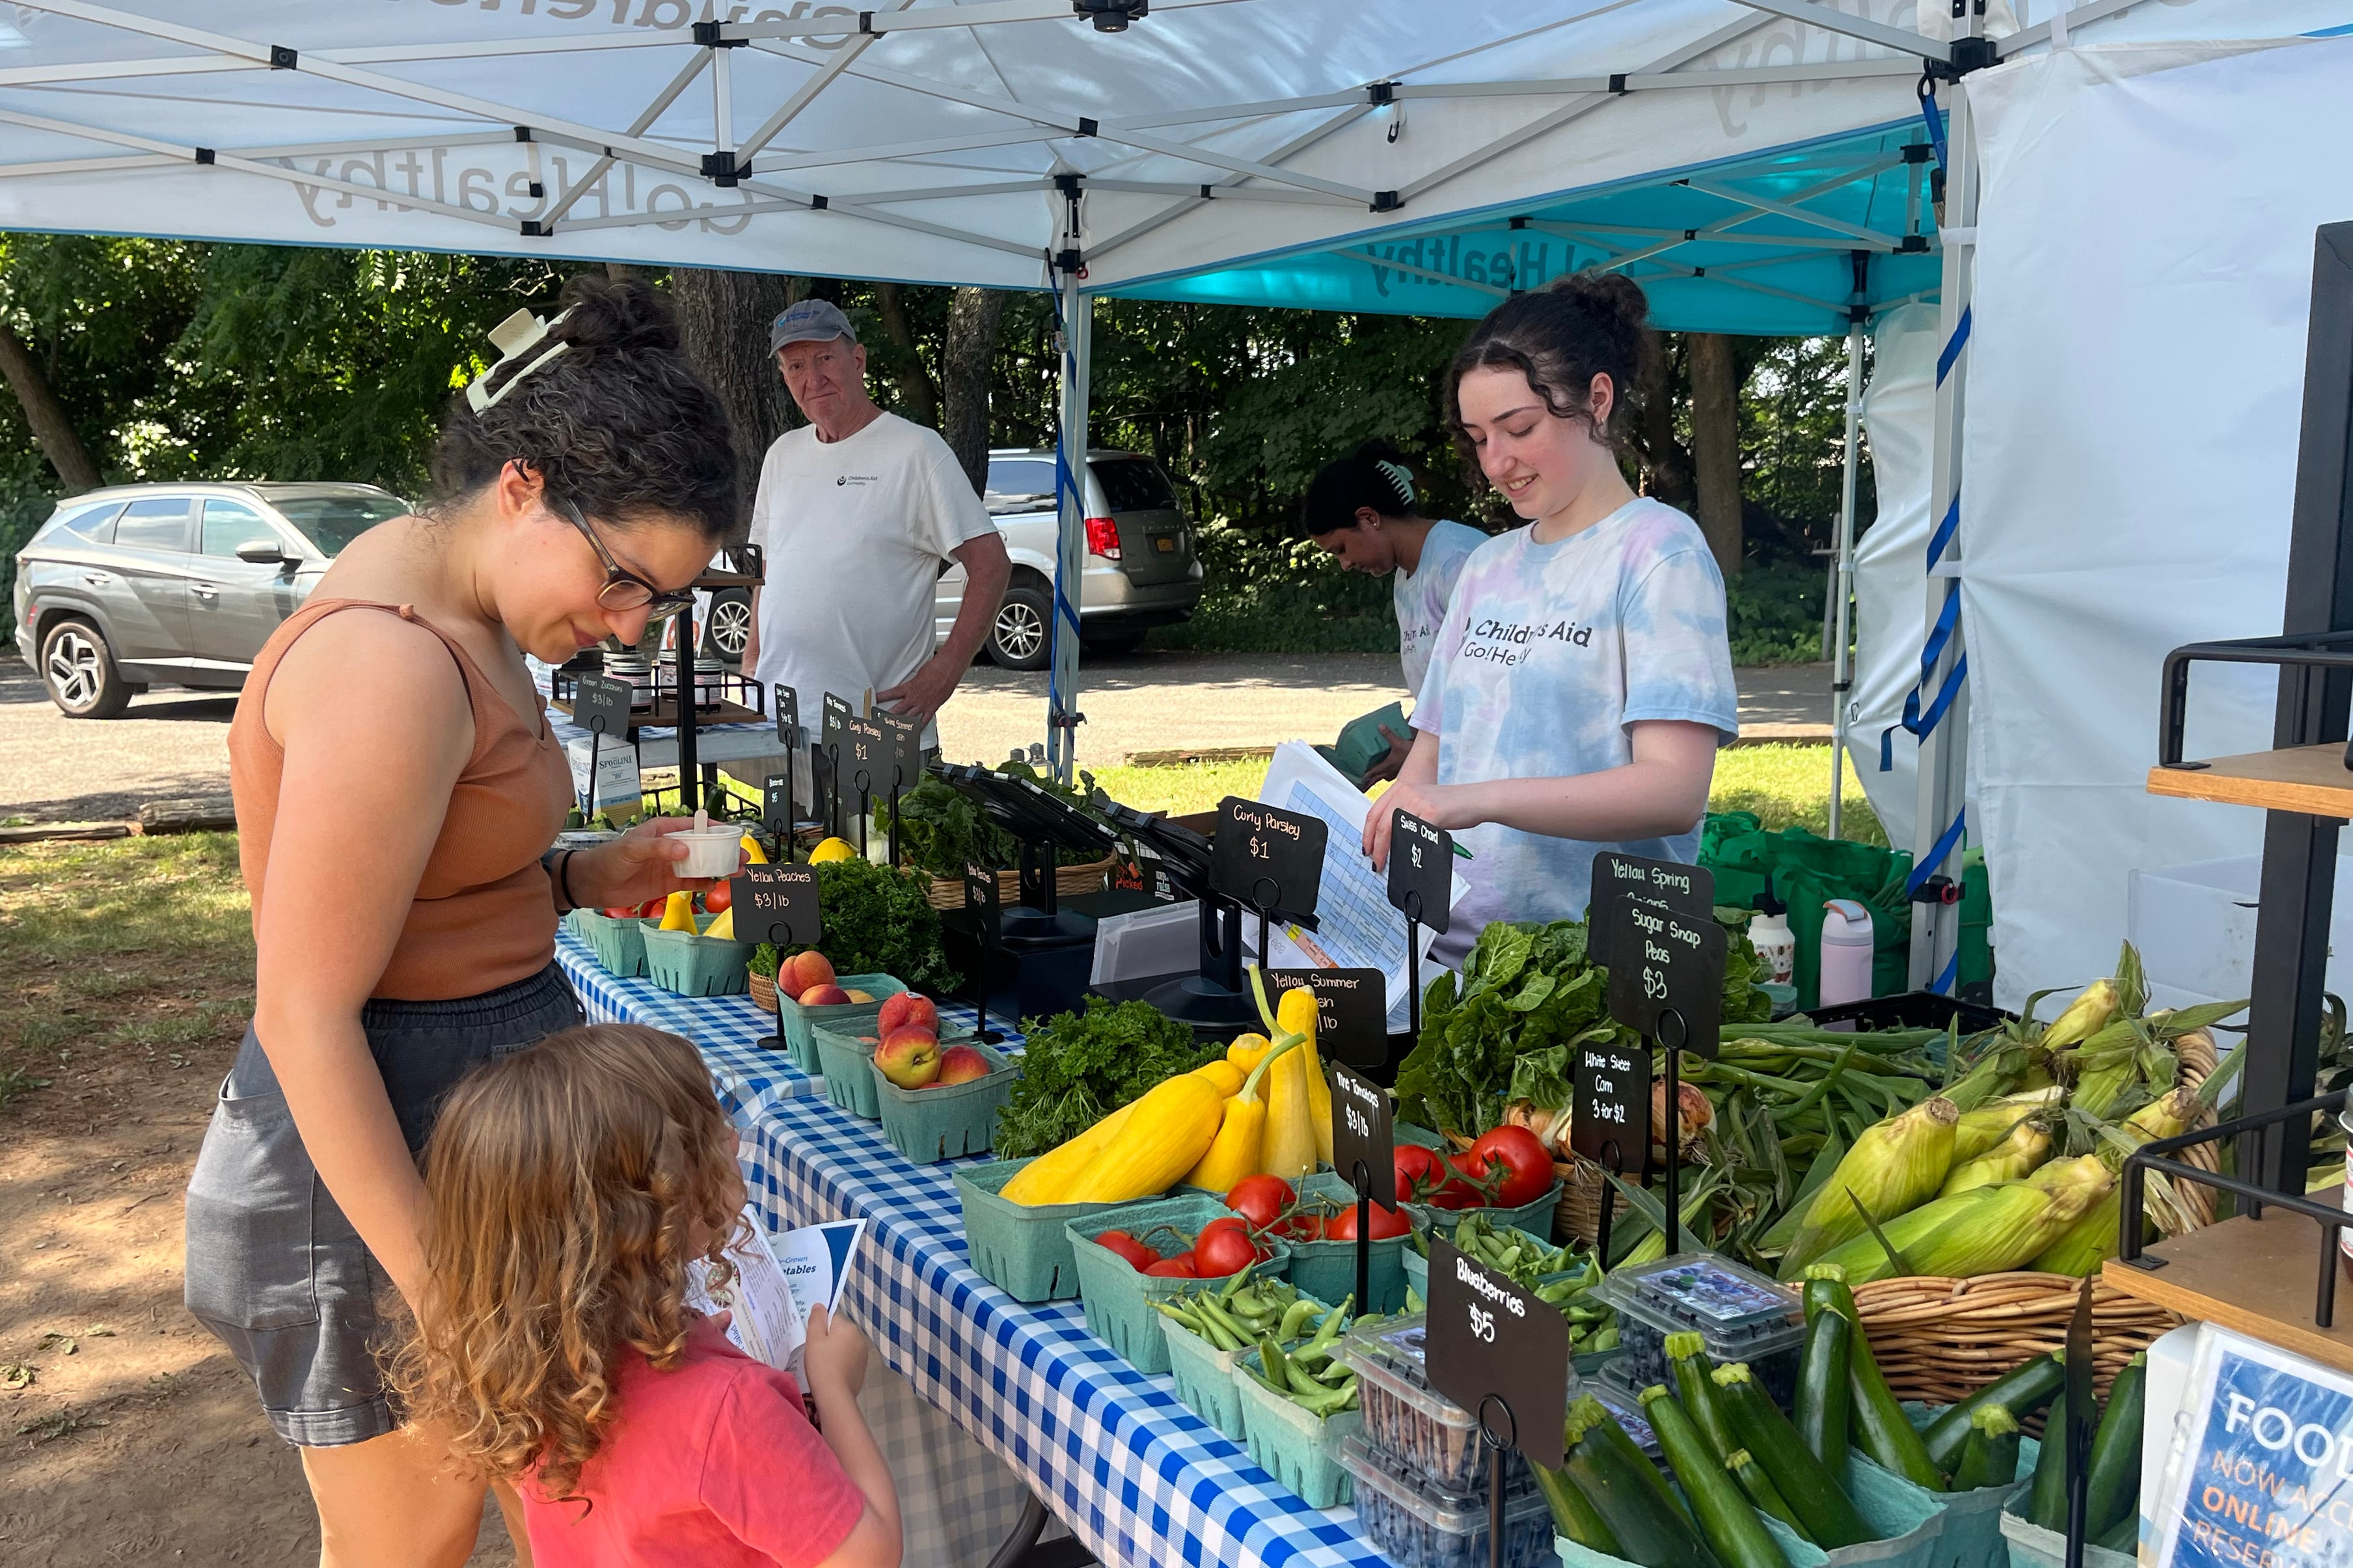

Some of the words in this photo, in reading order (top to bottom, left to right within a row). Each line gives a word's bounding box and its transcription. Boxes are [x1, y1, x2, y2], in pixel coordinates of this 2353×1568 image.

[1549, 621, 1592, 648] Aid
[582, 675, 597, 687] Green
[601, 680, 623, 693] Zucchini
[849, 720, 862, 734] Curly
[864, 722, 881, 741] Parsley
[599, 755, 632, 770] SFOGLINI
[856, 742, 867, 760] $1
[1233, 804, 1261, 831] Curly
[1265, 813, 1300, 841] Parsley
[1400, 815, 1417, 833] Swiss
[1421, 824, 1438, 845] Chard
[1249, 835, 1270, 859] $1
[1411, 843, 1422, 869] $2
[746, 868, 774, 883] Yellow
[775, 869, 811, 883] Peaches
[1115, 876, 1143, 891] Picked
[1611, 858, 1645, 880] Yellow
[1651, 867, 1691, 895] Spring
[1631, 908, 1665, 934] Sugar
[1669, 921, 1701, 949] Snap
[1645, 939, 1670, 964] Peas
[1311, 973, 1359, 989] Summer
[1642, 966, 1668, 999] $3
[1585, 1051, 1606, 1068] White
[1610, 1054, 1631, 1072] Sweet
[1336, 1072, 1350, 1092] Vine
[1350, 1078, 1379, 1108] Tomatoes
[1592, 1098, 1600, 1118] 3
[1601, 1103, 1613, 1119] for
[1614, 1102, 1625, 1124] $2
[1456, 1256, 1525, 1318] Blueberries
[1468, 1302, 1495, 1343] $5
[2212, 1450, 2286, 1497] NOW
[2202, 1486, 2317, 1554] ONLINE
